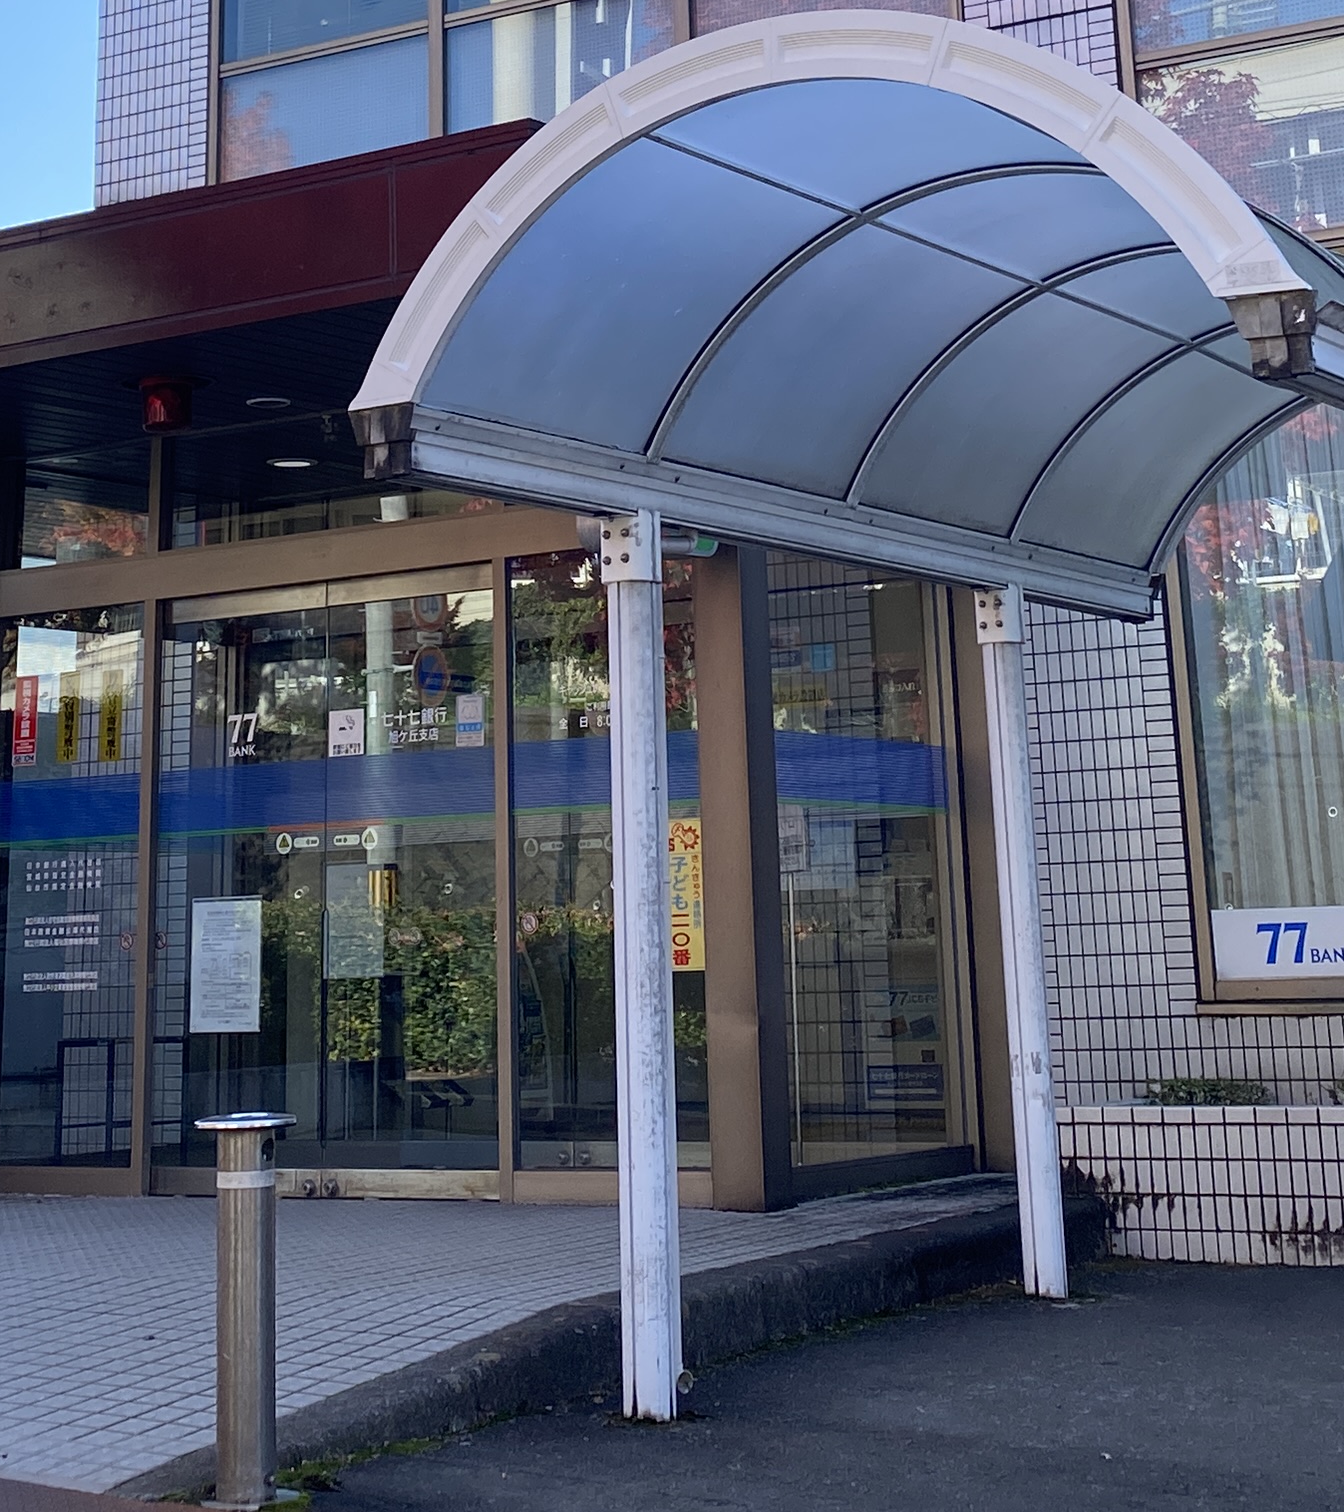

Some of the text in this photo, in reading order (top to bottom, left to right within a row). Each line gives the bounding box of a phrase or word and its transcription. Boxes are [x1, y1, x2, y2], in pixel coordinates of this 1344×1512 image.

[227, 713, 258, 757] 77 BANK
[381, 707, 447, 727] 七十七銀行
[1256, 922, 1308, 964] 77
